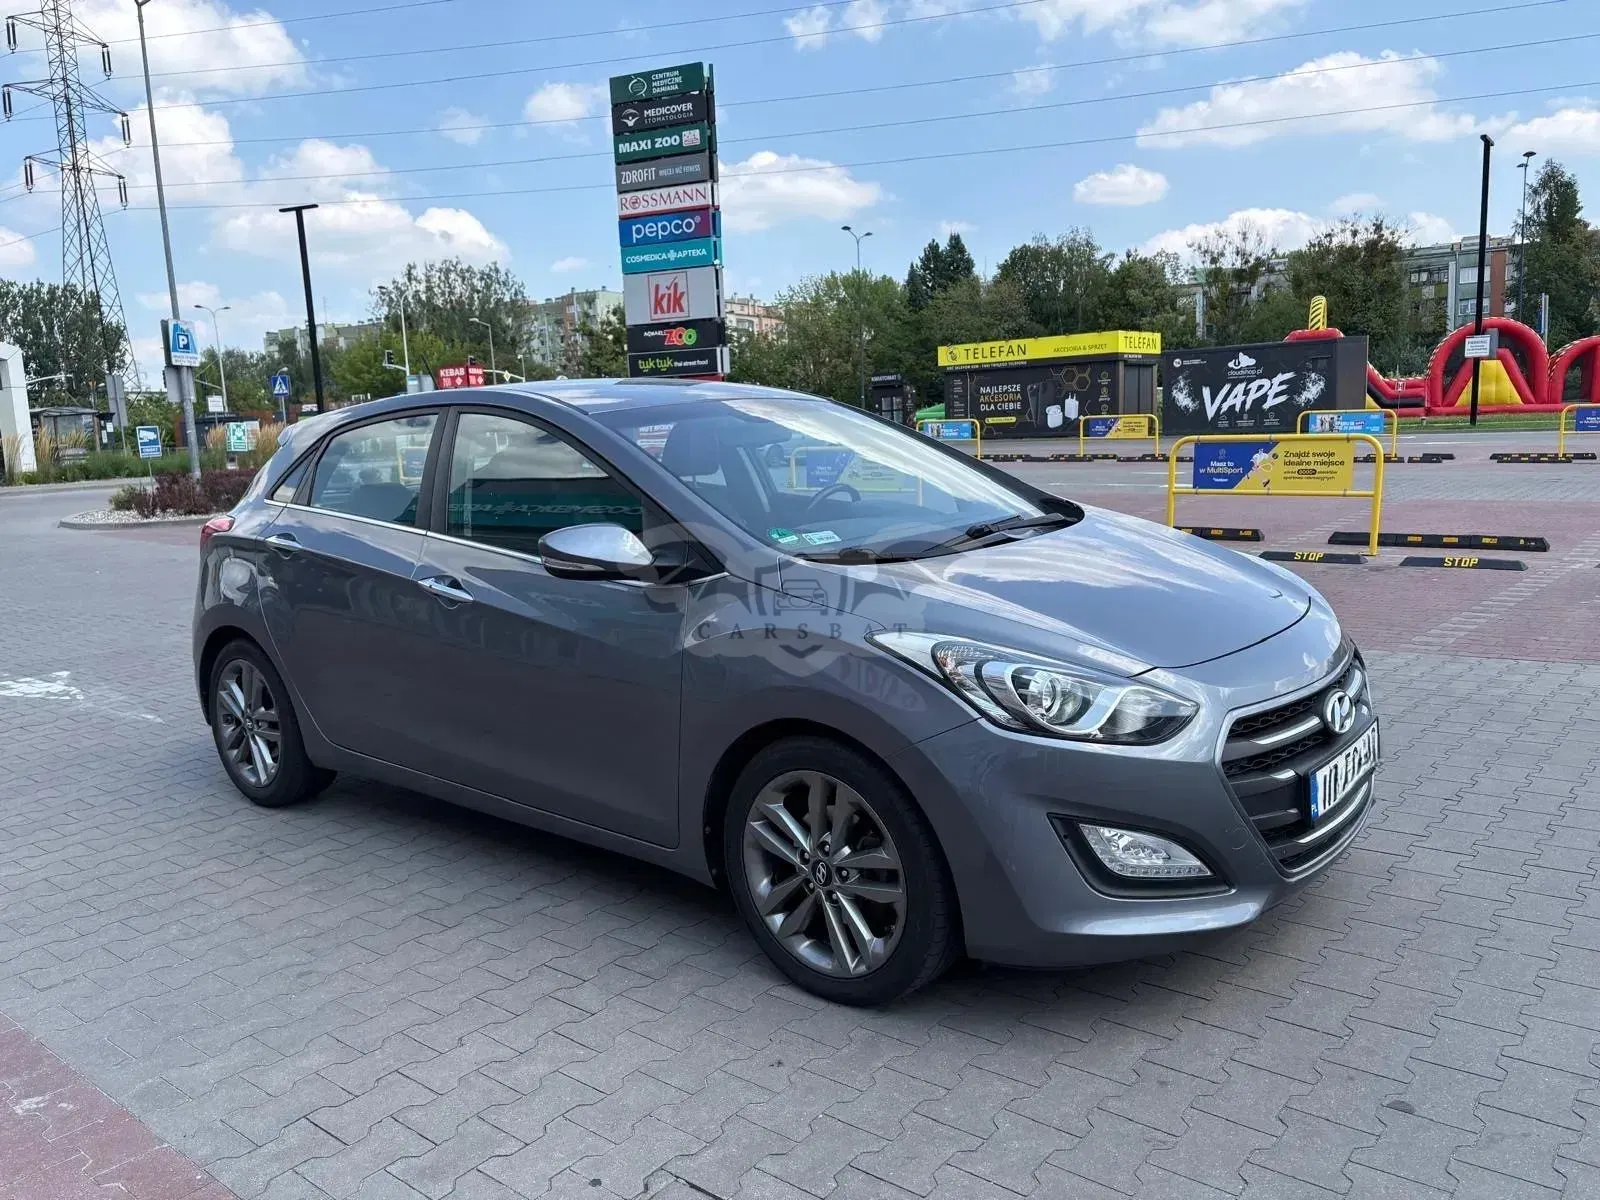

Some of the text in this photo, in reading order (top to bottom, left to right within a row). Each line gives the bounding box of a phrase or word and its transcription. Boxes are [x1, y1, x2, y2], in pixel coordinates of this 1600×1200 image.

[652, 70, 680, 80] CENTRUM
[652, 77, 682, 88] MEDYCZNE
[652, 84, 679, 94] DAMIANA
[643, 102, 693, 117] MEDICOVER
[644, 112, 694, 125] STOMATOLOGIA
[618, 135, 680, 153] MAXI ZOO
[621, 167, 656, 185] ZDROFIT
[620, 187, 707, 211] ROSSMANN
[632, 218, 695, 243] pepco
[626, 248, 707, 264] COSMEDICA APTEKA
[1124, 335, 1157, 350] TELEFAN
[964, 344, 1027, 360] TELEFAN
[638, 357, 656, 370] tuk
[656, 356, 674, 370] tuk
[440, 368, 464, 378] KEBAB
[980, 384, 1021, 394] NAJLEPSZE
[980, 393, 1022, 403] AKCESORIA
[1202, 371, 1297, 422] VAPE
[980, 402, 1022, 412] DLA CIEBIE
[1284, 450, 1336, 459] Znajdź swoje
[1314, 460, 1345, 468] miejsce
[1206, 466, 1243, 475] MultiSport
[1294, 552, 1324, 561] STOP
[1444, 557, 1478, 568] STOP
